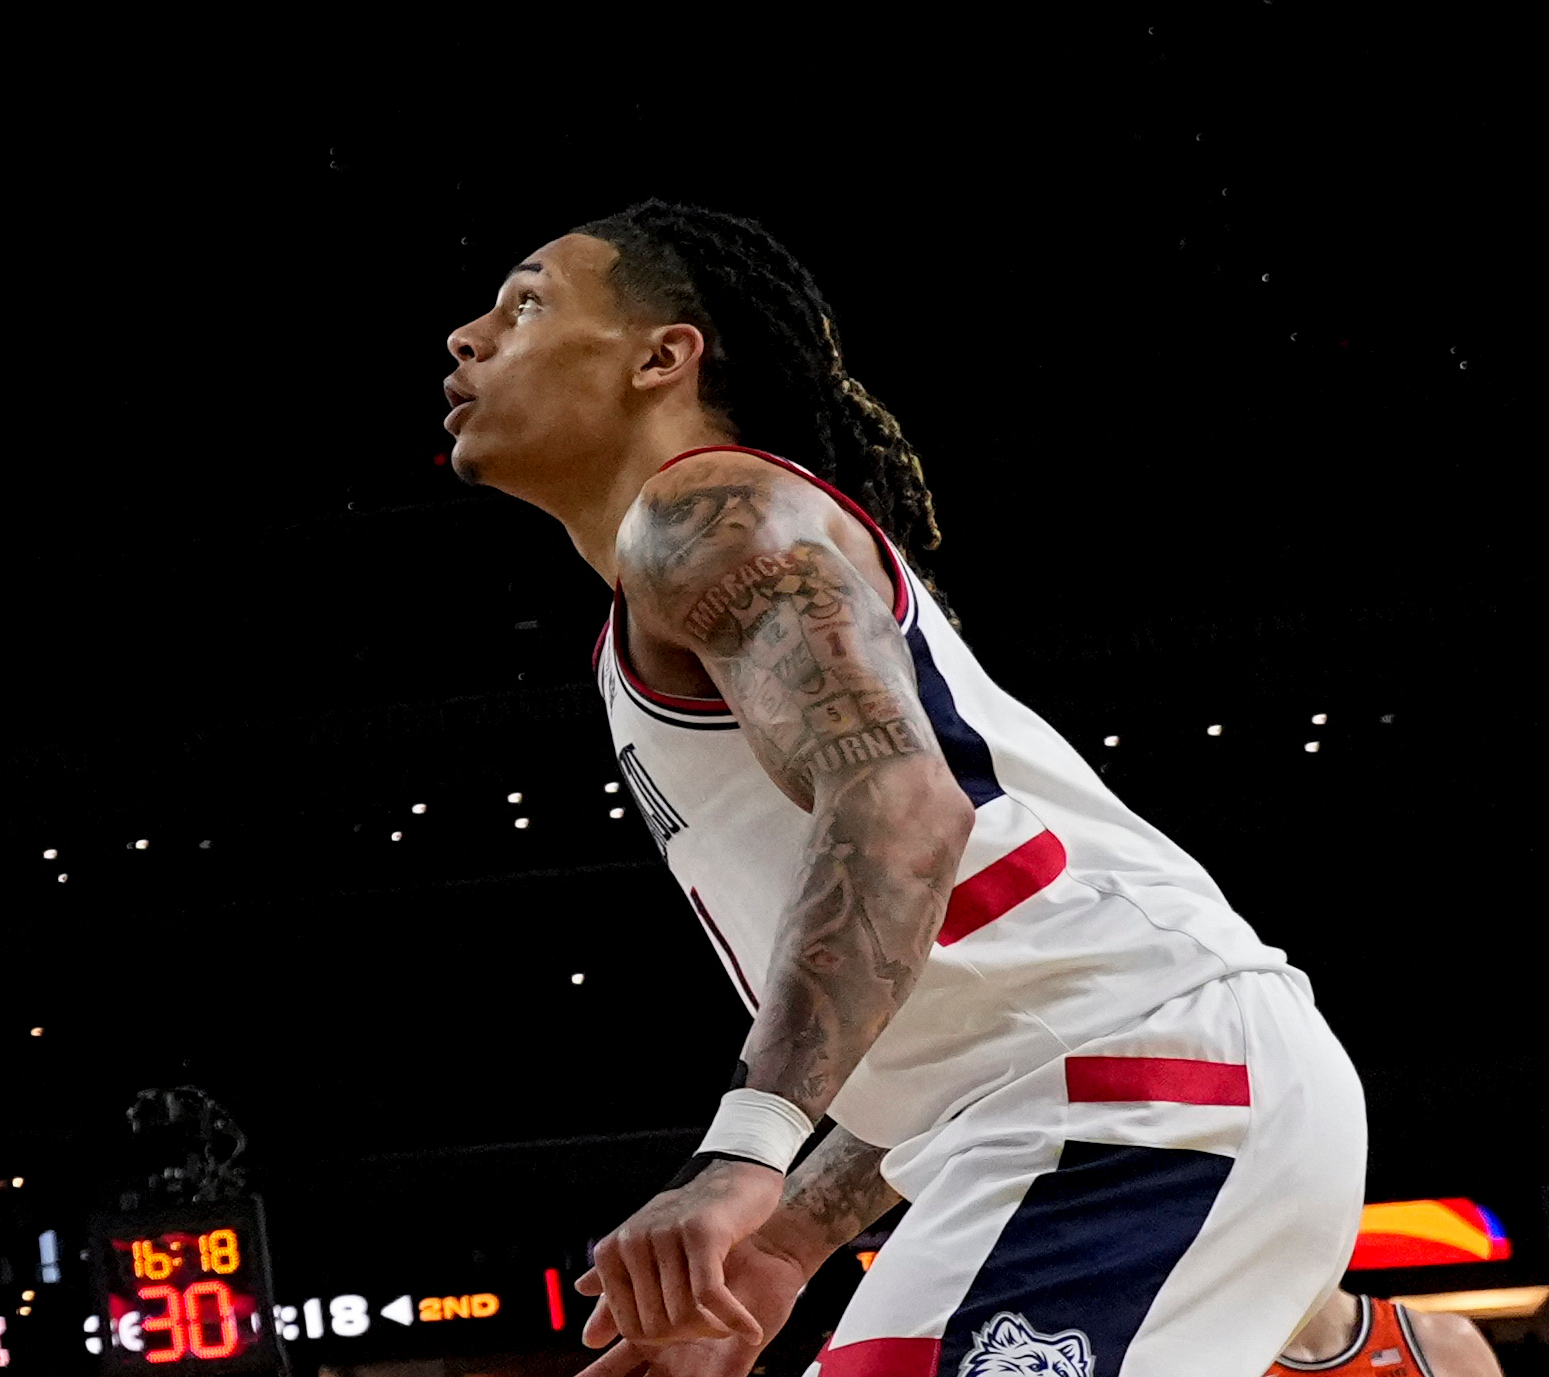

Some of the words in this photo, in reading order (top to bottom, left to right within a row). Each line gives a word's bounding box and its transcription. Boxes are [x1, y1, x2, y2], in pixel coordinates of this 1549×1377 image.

[132, 1229, 239, 1280] 16:18
[138, 1280, 239, 1363] 30
[419, 1293, 500, 1321] 2ND
